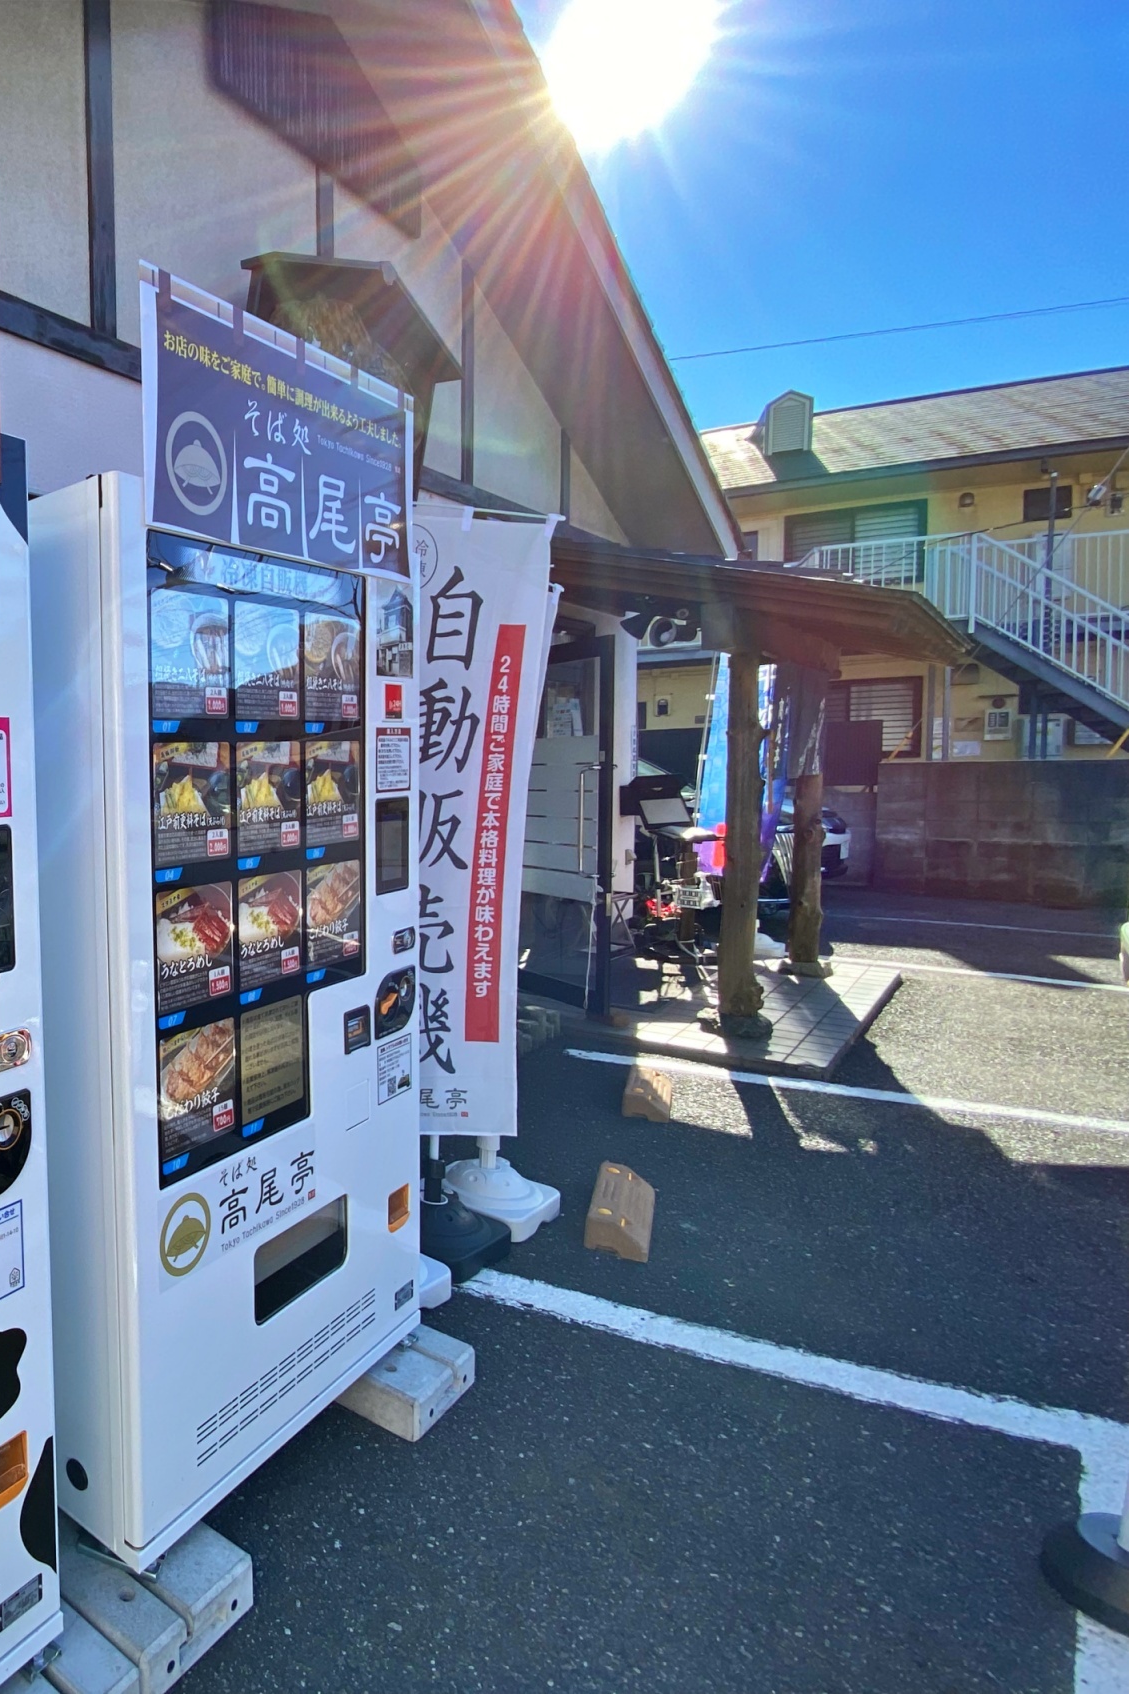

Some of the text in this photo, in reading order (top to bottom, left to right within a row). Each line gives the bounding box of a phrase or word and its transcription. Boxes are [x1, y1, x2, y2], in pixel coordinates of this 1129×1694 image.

[244, 399, 312, 456] そば処
[317, 434, 334, 449] Tokyo
[243, 453, 402, 564] 高尾亭
[221, 556, 308, 595] 冷凍自販機
[472, 655, 512, 998] 24時間ご家庭で本格料理が味わえます
[240, 936, 285, 959] うなとろめし
[161, 953, 213, 981] うなとろめし
[219, 1156, 258, 1187] そば処
[219, 1150, 315, 1235] 高尾亭
[221, 1236, 241, 1252] Tokyo
[242, 1218, 274, 1240] Tachikawa
